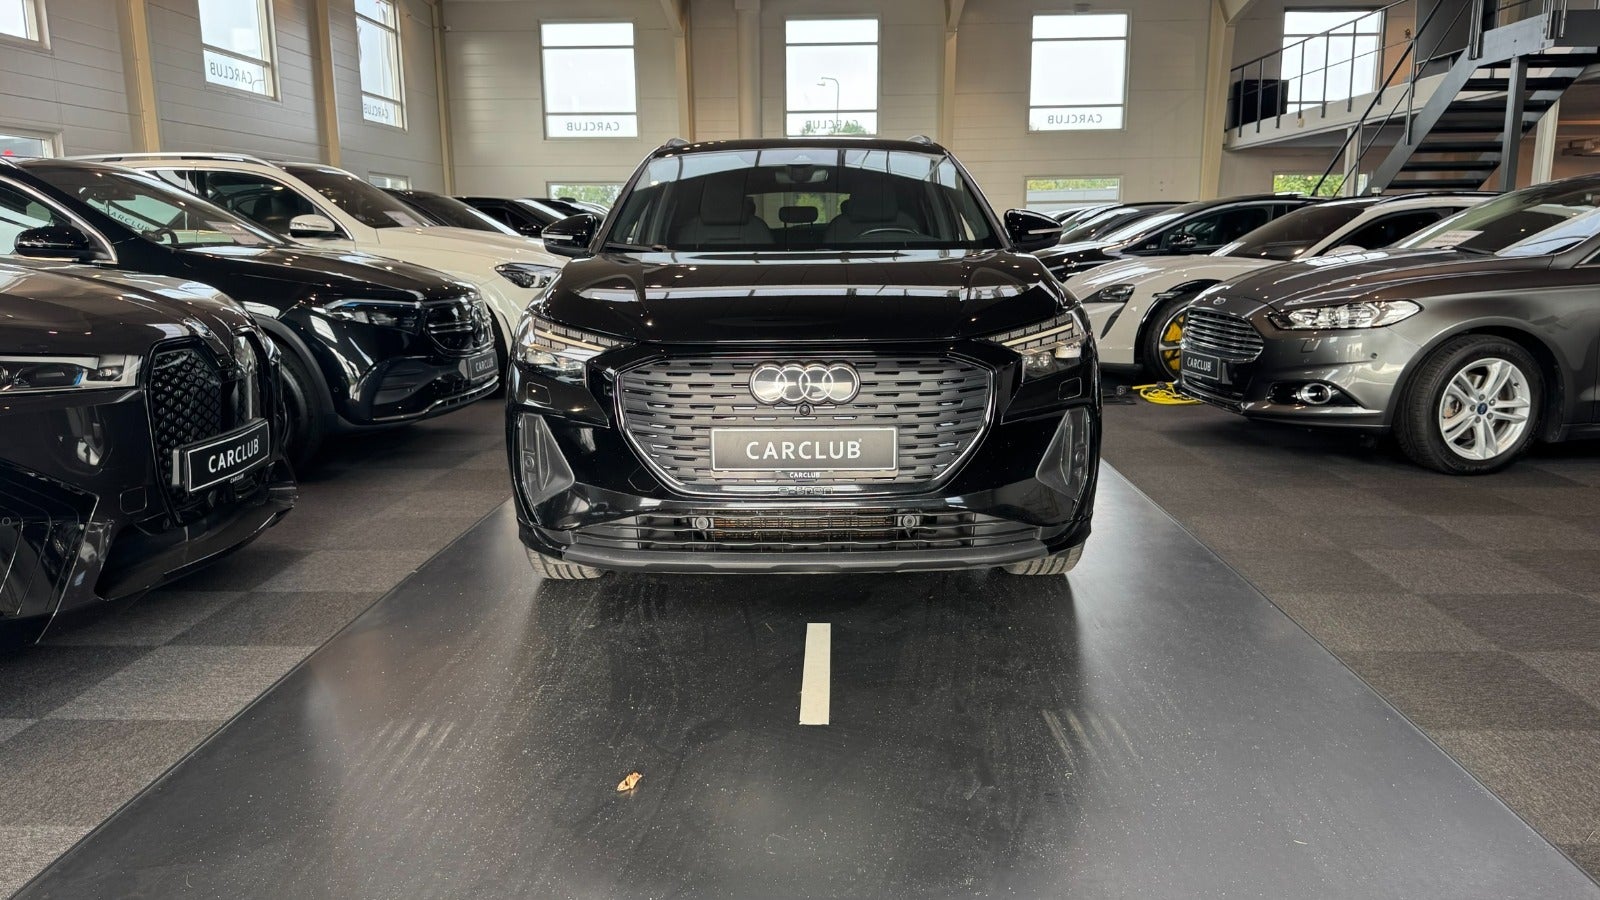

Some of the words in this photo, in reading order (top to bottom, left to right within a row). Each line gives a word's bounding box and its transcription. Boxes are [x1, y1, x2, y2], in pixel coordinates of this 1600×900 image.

[1187, 356, 1212, 371] CARCLUB
[208, 438, 259, 473] CARCLUB
[746, 440, 862, 460] CARCLUB
